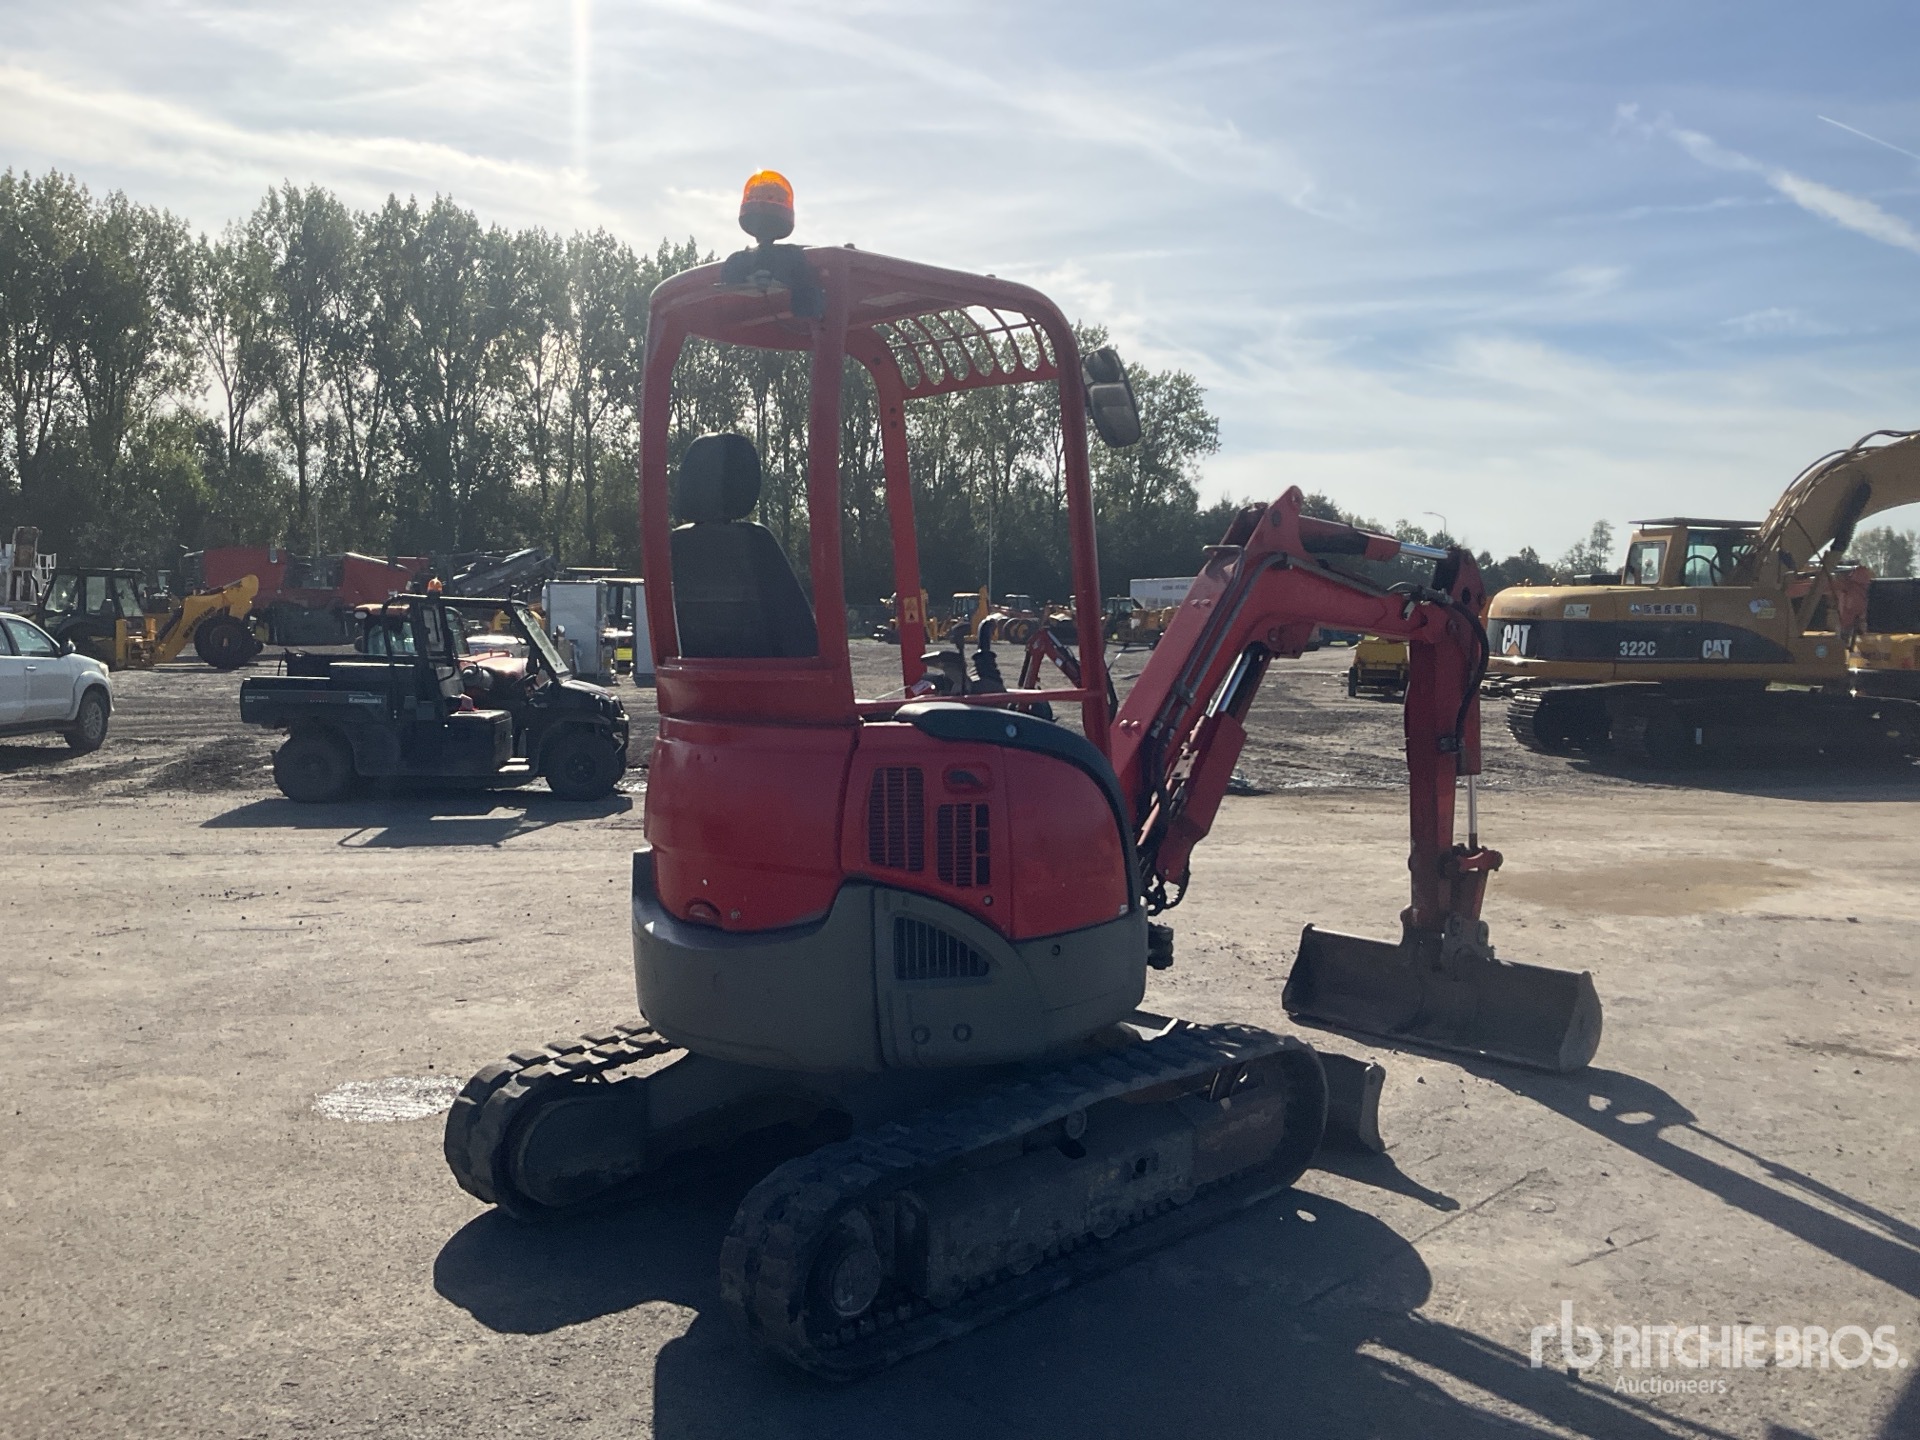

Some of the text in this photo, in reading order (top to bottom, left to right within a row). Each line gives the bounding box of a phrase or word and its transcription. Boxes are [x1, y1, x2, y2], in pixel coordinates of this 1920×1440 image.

[1502, 624, 1531, 655] CAT
[1620, 641, 1656, 656] 322C
[1702, 640, 1732, 659] CAT
